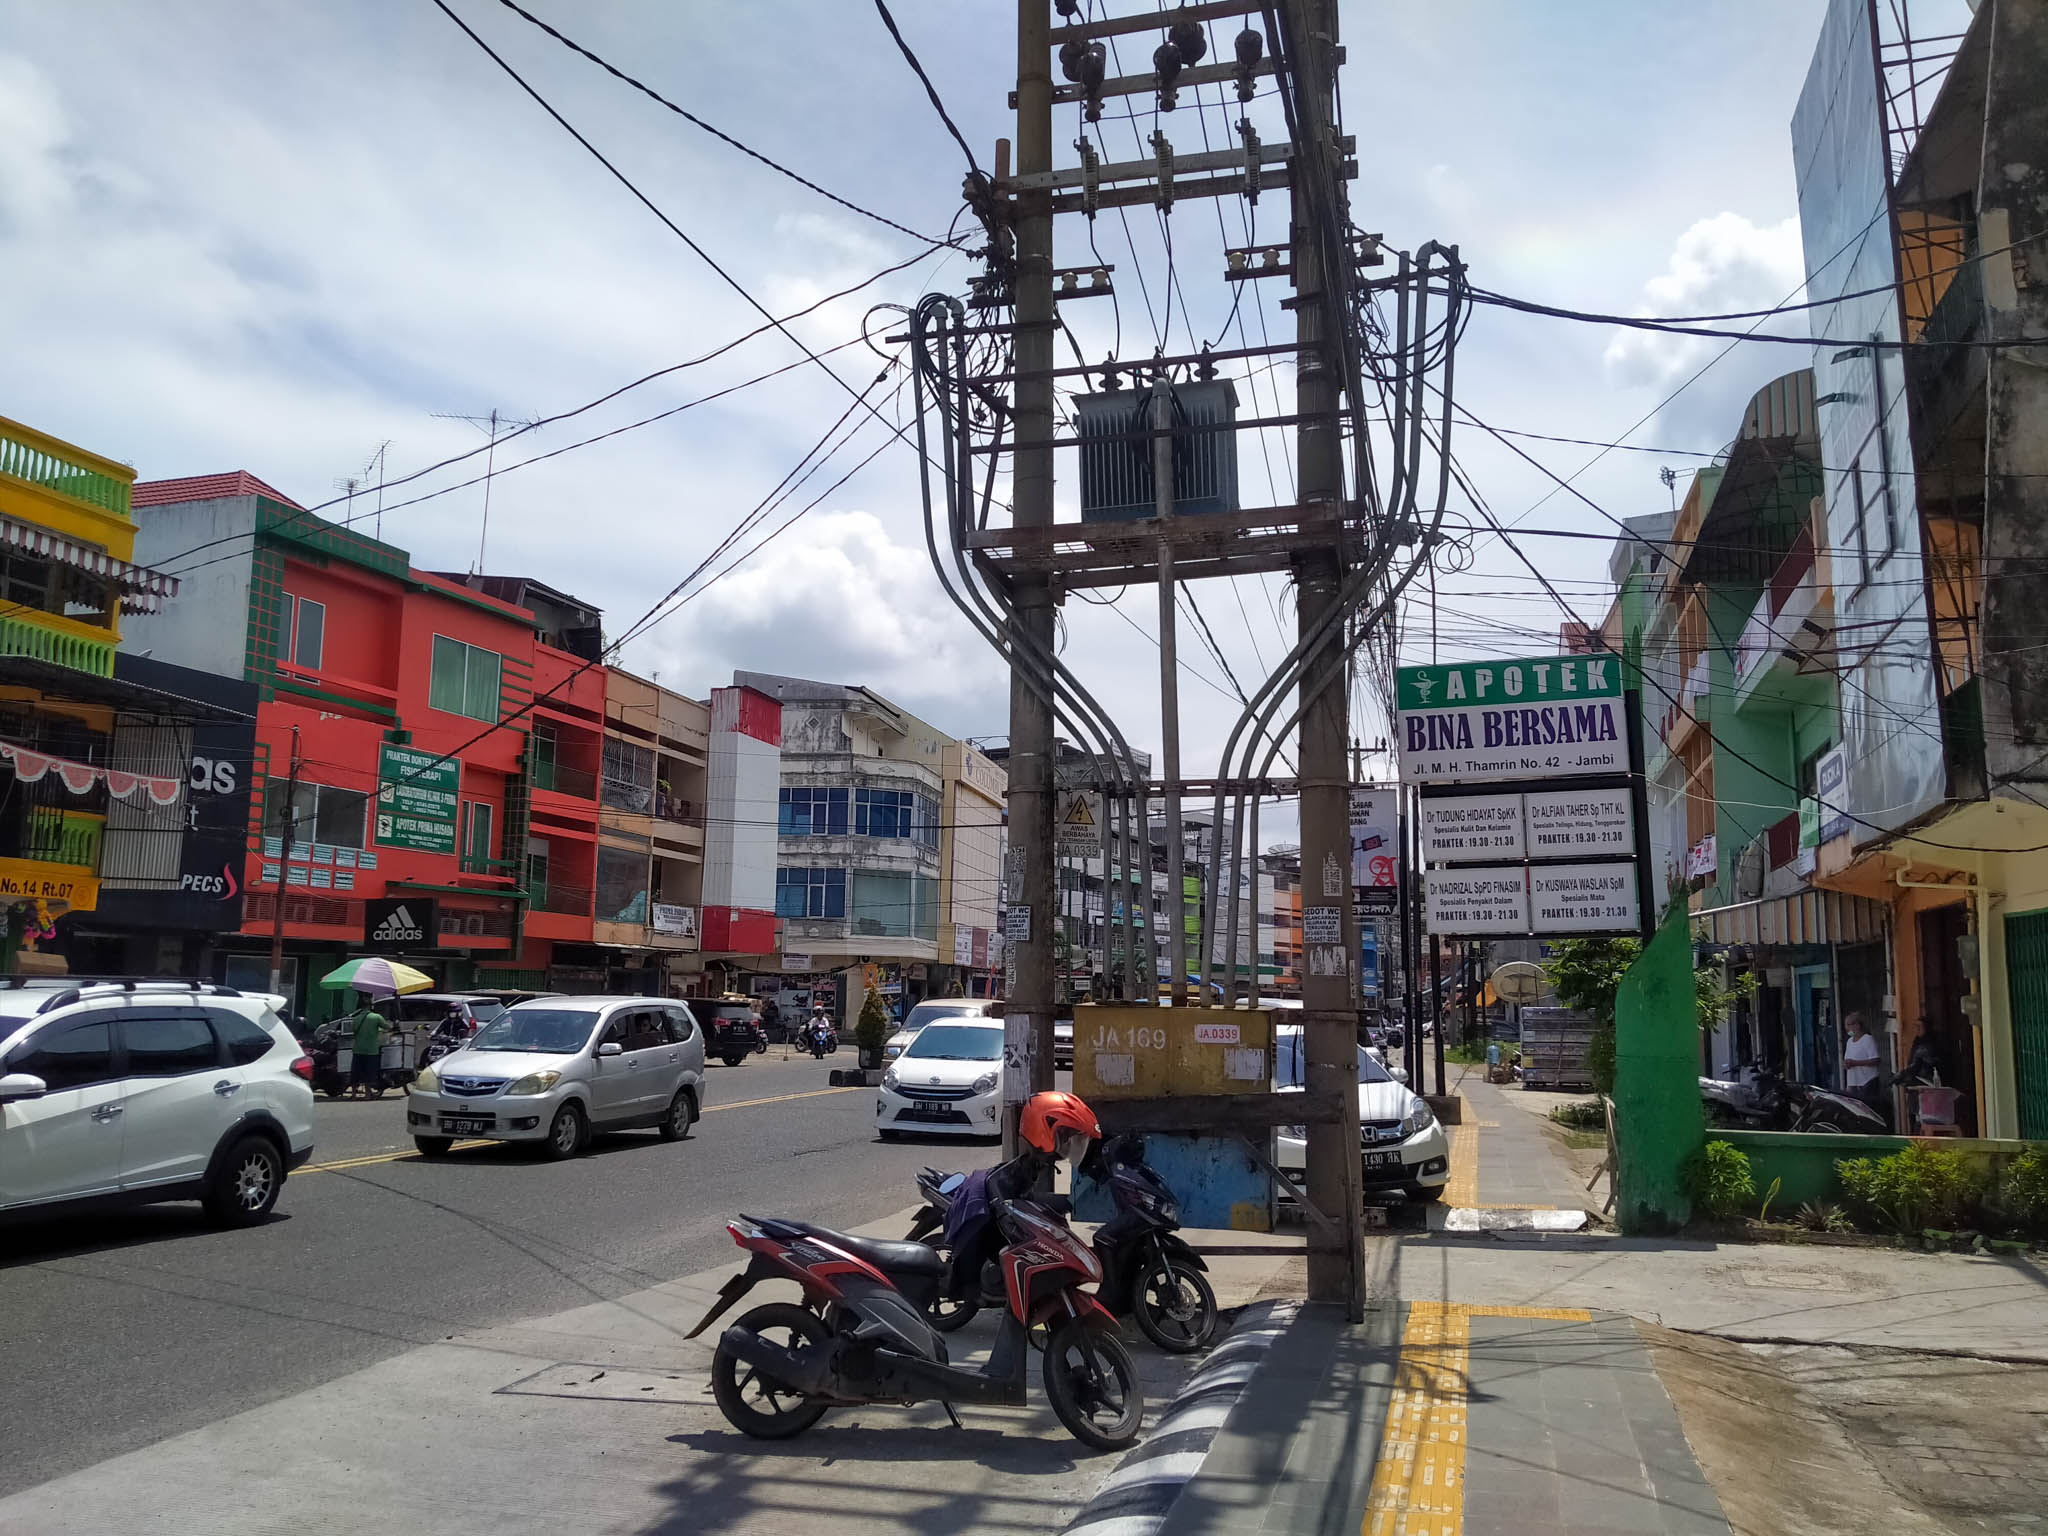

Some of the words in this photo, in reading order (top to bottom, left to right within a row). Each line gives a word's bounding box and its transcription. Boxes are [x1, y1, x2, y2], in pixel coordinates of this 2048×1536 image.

[1446, 660, 1609, 700] APOTEK
[1405, 713, 1474, 752] BINA
[1482, 704, 1618, 748] BERSAMA
[386, 750, 411, 763] PRAKTEK
[1414, 764, 1428, 775] Jl.
[1432, 763, 1446, 773] M.
[1449, 762, 1462, 773] H.
[1465, 758, 1517, 771] Thamrin
[1520, 757, 1542, 769] No.
[1545, 756, 1560, 768] 42
[1575, 753, 1614, 767] Jambi
[1352, 801, 1373, 809] SABAR
[1532, 806, 1540, 818] Dr
[1541, 805, 1565, 817] ALFIAN
[1566, 804, 1589, 816] TAHER
[1590, 803, 1599, 818] Sp
[1600, 803, 1613, 815] THT
[1615, 802, 1624, 814] KL
[1427, 811, 1435, 823] Dr
[1436, 809, 1466, 823] TUDUNG
[1467, 808, 1495, 821] HIDAYAT
[1497, 807, 1517, 822] SpKK
[396, 818, 417, 831] APOTEK
[1434, 825, 1459, 834] Spesialis
[1461, 825, 1474, 833] Kulit
[1476, 824, 1487, 832] Dan
[1432, 838, 1464, 848] PRAKTEK
[1469, 837, 1489, 847] 19.30
[1495, 836, 1514, 846] 21.30
[1538, 833, 1570, 844] PRAKTEK
[1576, 832, 1596, 843] 19.30
[1602, 831, 1622, 842] 21.30
[1074, 845, 1098, 856] 0339
[41, 881, 74, 898] Rt.07
[181, 874, 224, 893] PECS
[1430, 883, 1437, 895] Dr
[1440, 882, 1472, 894] NADRIZAL
[1474, 881, 1492, 896] SpPD
[1494, 881, 1520, 893] FINASIM
[1536, 880, 1544, 892] Dr
[1545, 878, 1578, 892] KUSWAYA
[1579, 878, 1608, 890] WASLAN
[1610, 877, 1624, 892] SpM
[1440, 898, 1466, 907] Spesialis
[1467, 897, 1493, 907] Penyakit
[1494, 897, 1513, 905] Dalam
[1561, 894, 1588, 903] Spesialis
[1590, 893, 1605, 901] Mata
[1327, 907, 1339, 915] WC
[1436, 910, 1467, 920] PRAKTEK
[1472, 910, 1492, 920] 19.30
[1498, 909, 1518, 920] 21.30
[1542, 908, 1574, 918] PRAKTEK
[1580, 907, 1600, 918] 19.30
[1606, 906, 1627, 917] 21.30
[373, 926, 423, 941] adidas
[1093, 1025, 1120, 1048] JA
[1128, 1026, 1166, 1050] 169
[1199, 1028, 1239, 1040] JA.0339
[1037, 1241, 1065, 1260] HONDA
